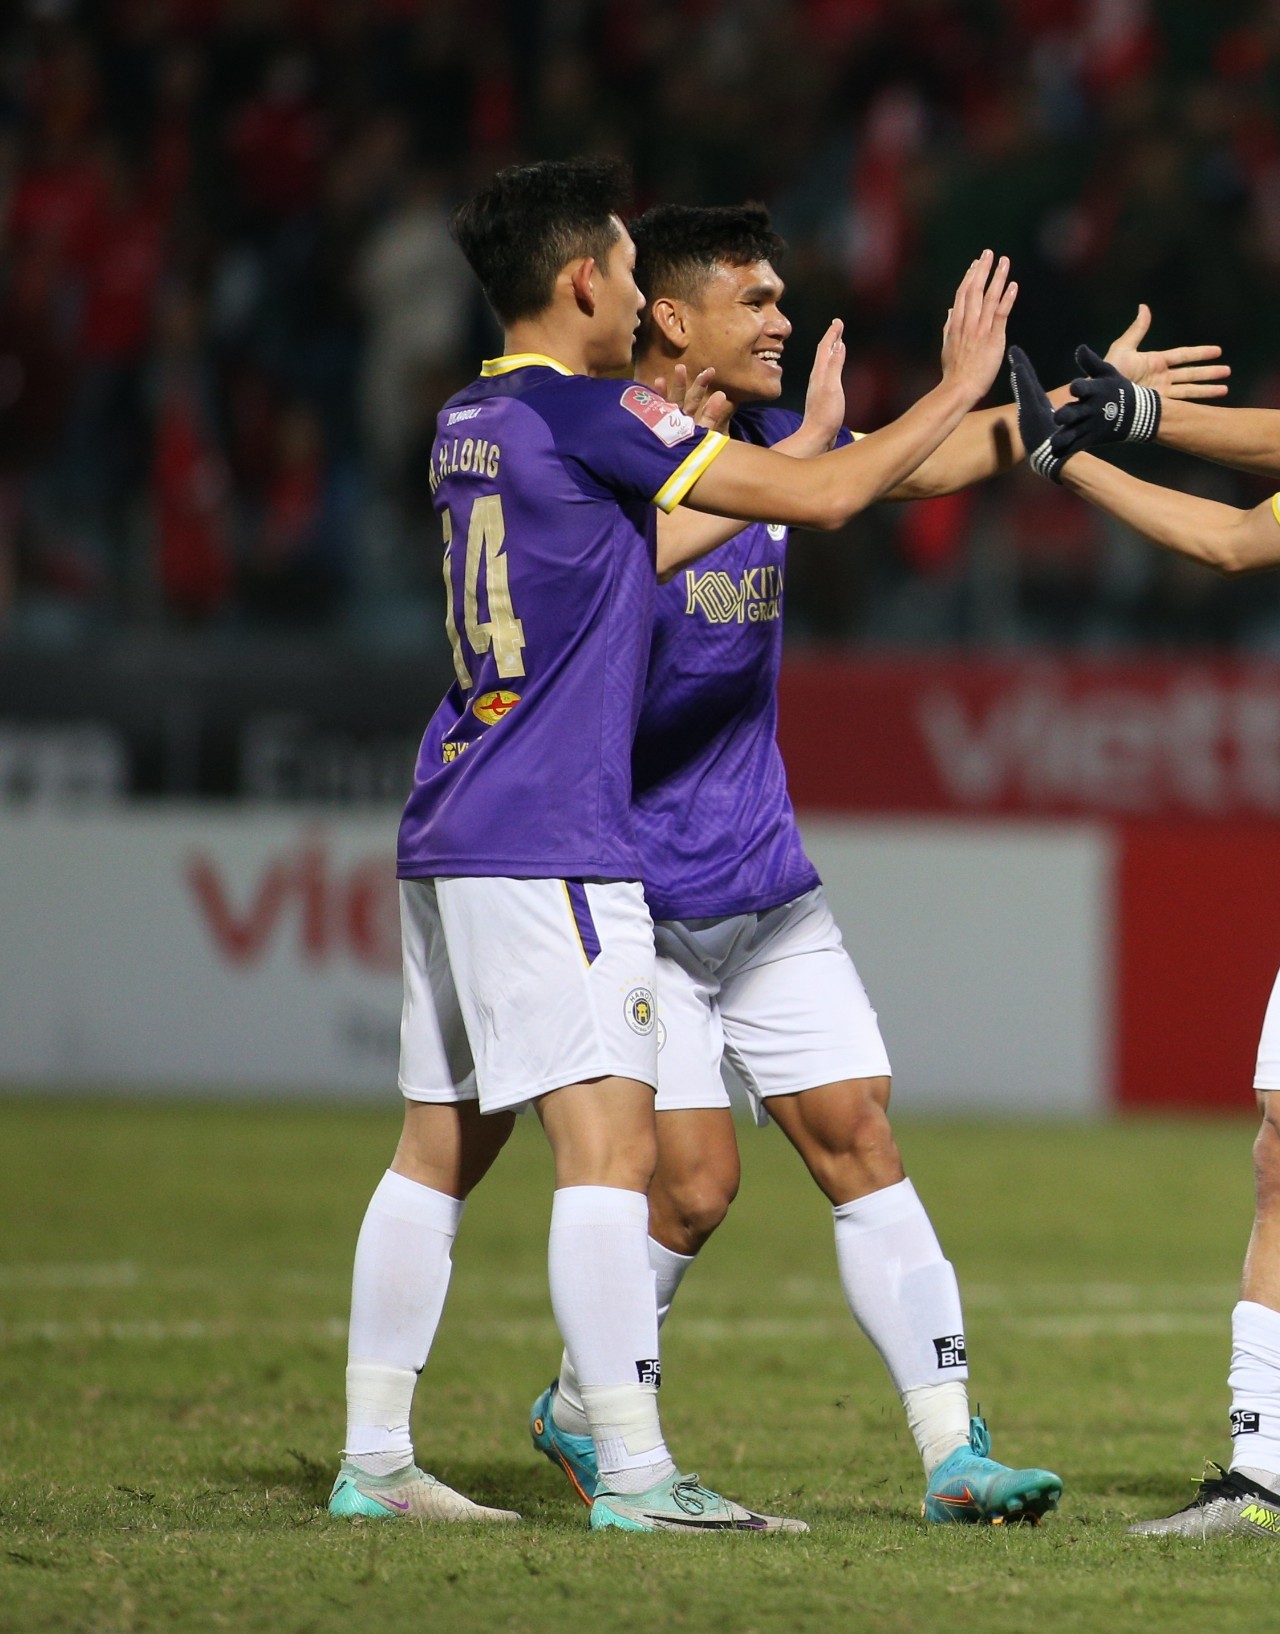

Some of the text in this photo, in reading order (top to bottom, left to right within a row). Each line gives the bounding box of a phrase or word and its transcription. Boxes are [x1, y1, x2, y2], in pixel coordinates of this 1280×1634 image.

[441, 494, 526, 691] 14
[941, 1336, 965, 1352] JG
[941, 1350, 967, 1367] BL
